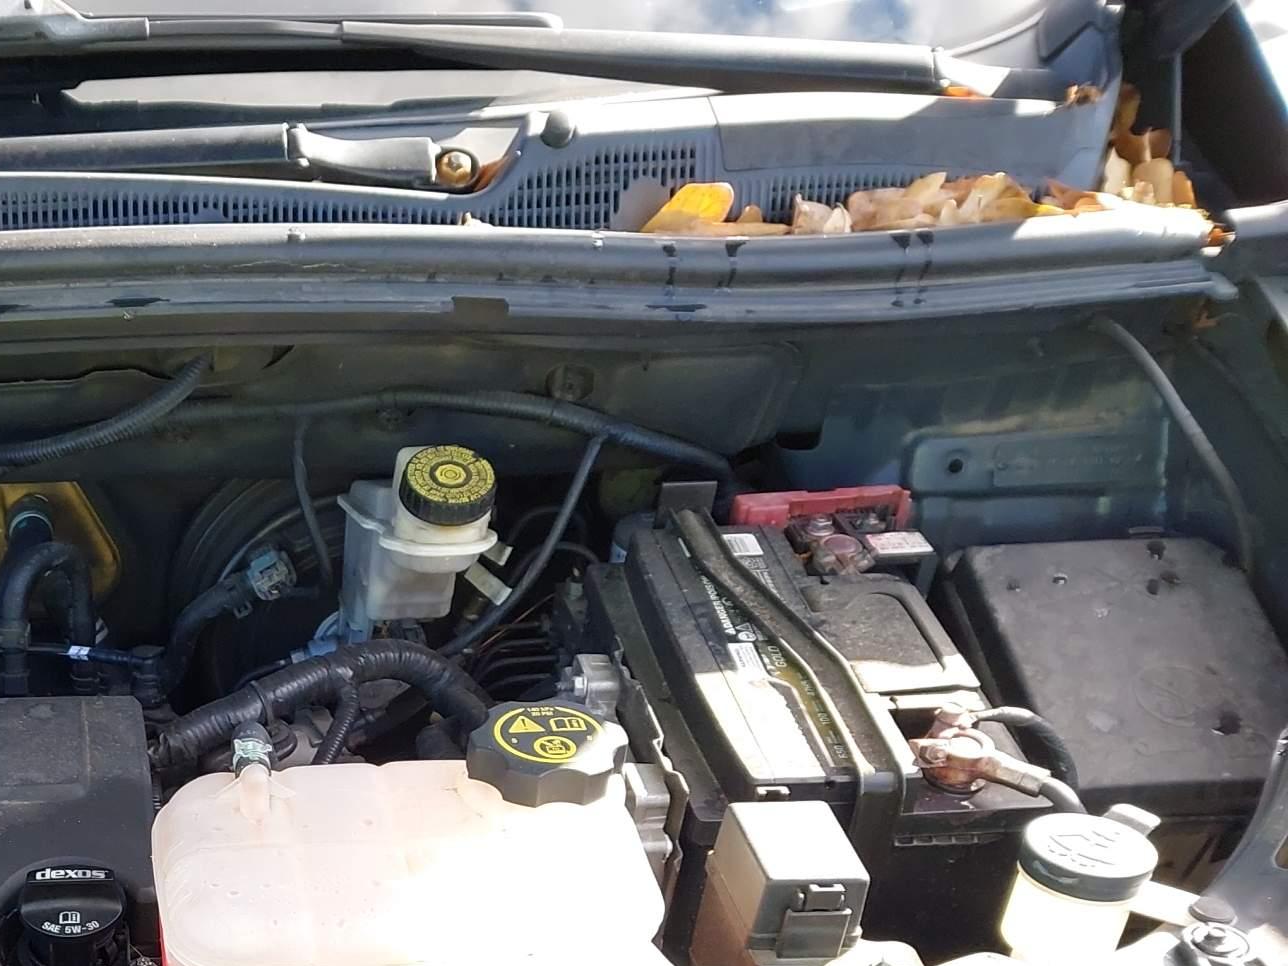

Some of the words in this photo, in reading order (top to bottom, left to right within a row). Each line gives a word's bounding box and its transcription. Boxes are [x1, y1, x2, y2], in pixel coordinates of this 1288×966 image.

[768, 645, 787, 668] GOLD
[41, 921, 62, 934] SAE
[64, 920, 100, 934] 5W-30
